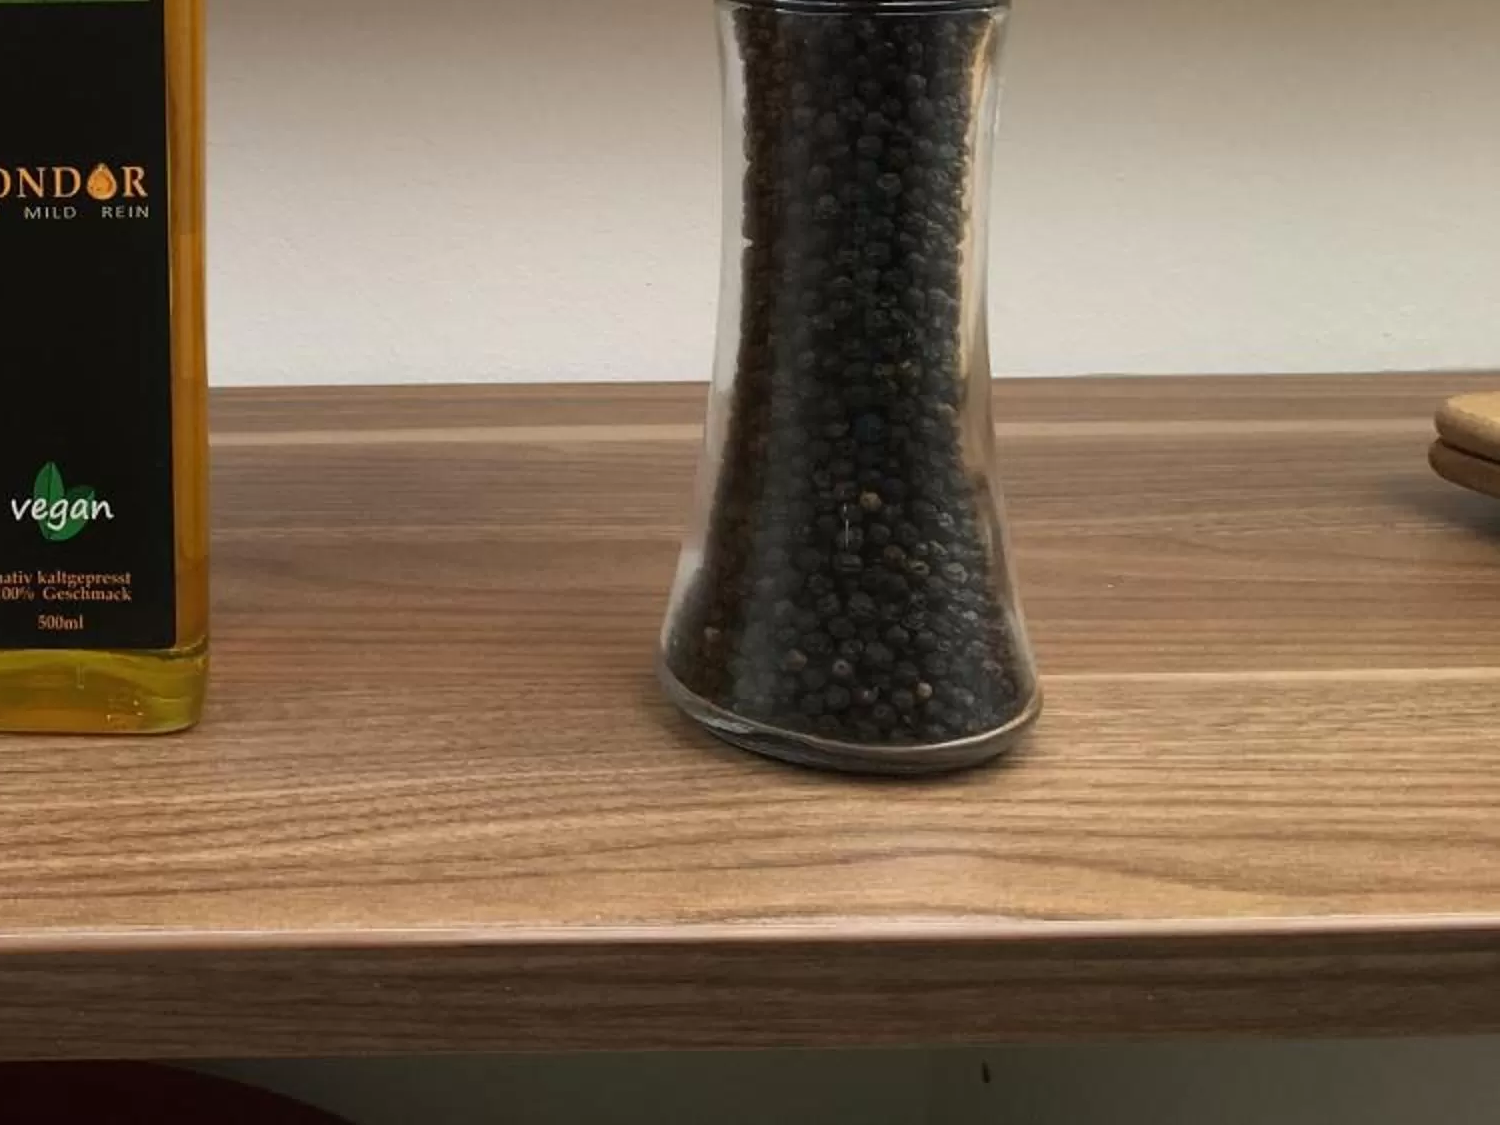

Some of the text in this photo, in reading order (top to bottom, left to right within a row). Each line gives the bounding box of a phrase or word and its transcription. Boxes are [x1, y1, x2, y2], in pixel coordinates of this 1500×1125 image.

[23, 206, 77, 220] MILD
[101, 205, 150, 219] REIN
[10, 497, 115, 531] vegan
[37, 570, 132, 589] kaltgepresst
[42, 585, 133, 602] Geschmack
[37, 614, 84, 630] 500ml
